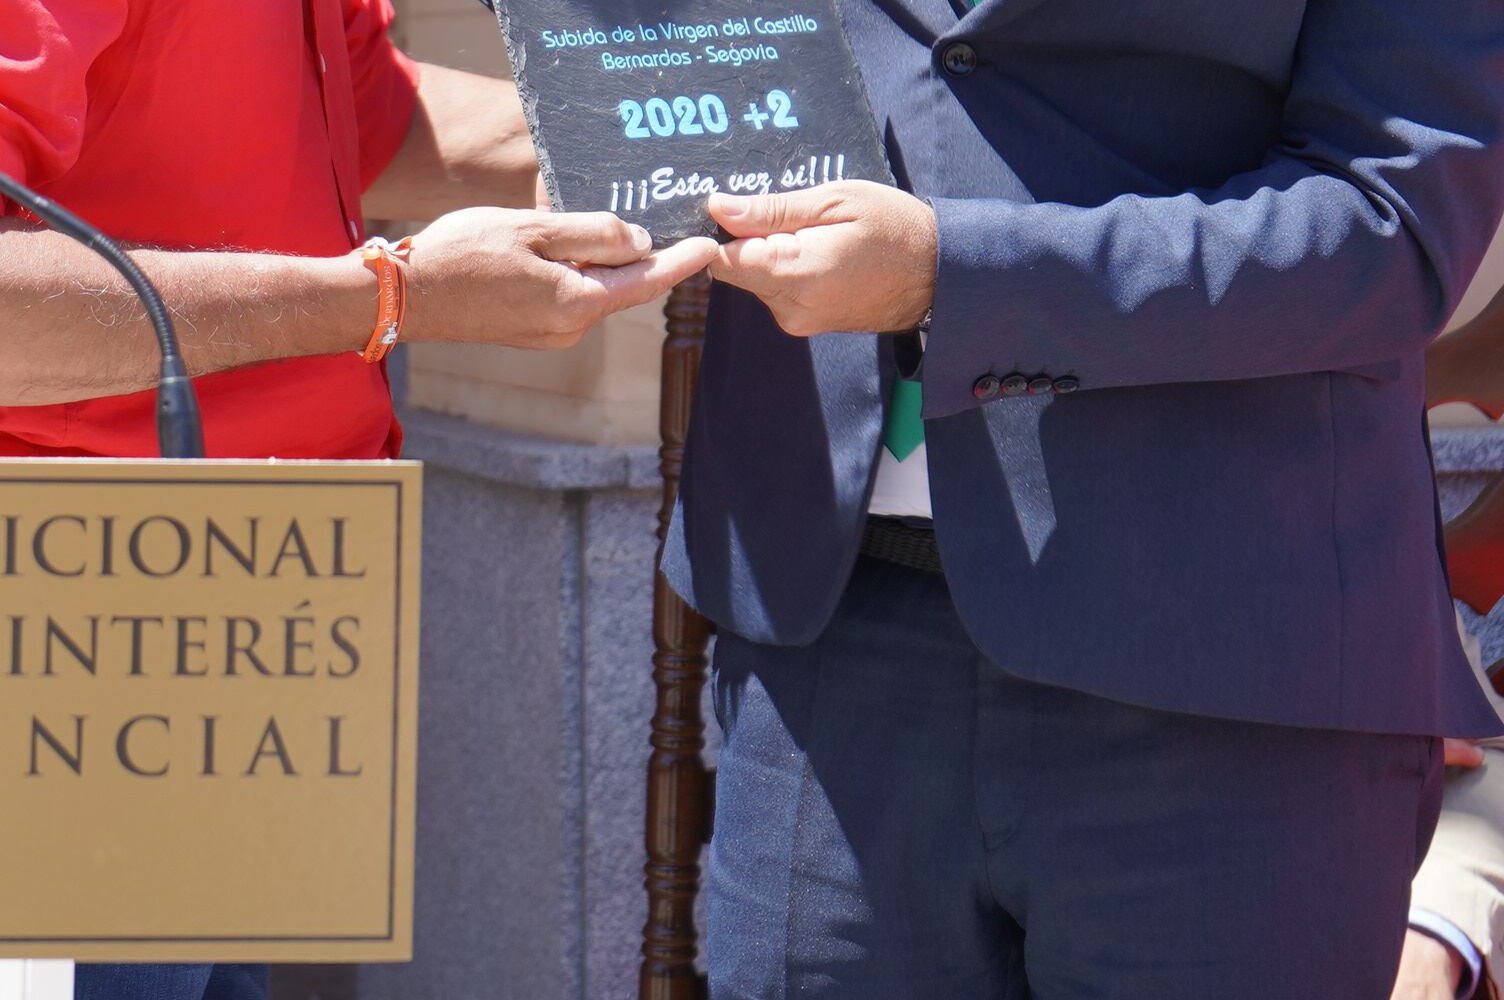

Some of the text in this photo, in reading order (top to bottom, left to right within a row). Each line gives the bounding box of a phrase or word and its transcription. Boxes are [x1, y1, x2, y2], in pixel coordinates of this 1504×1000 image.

[542, 15, 817, 48] Subida de la Virgen del Castillo
[601, 49, 692, 70] Bernardos
[706, 43, 778, 66] Segovia
[619, 89, 799, 138] 2020 +2
[611, 167, 719, 212] ¡¡¡Esta
[728, 171, 773, 195] vez
[9, 600, 360, 677] INTERÉS
